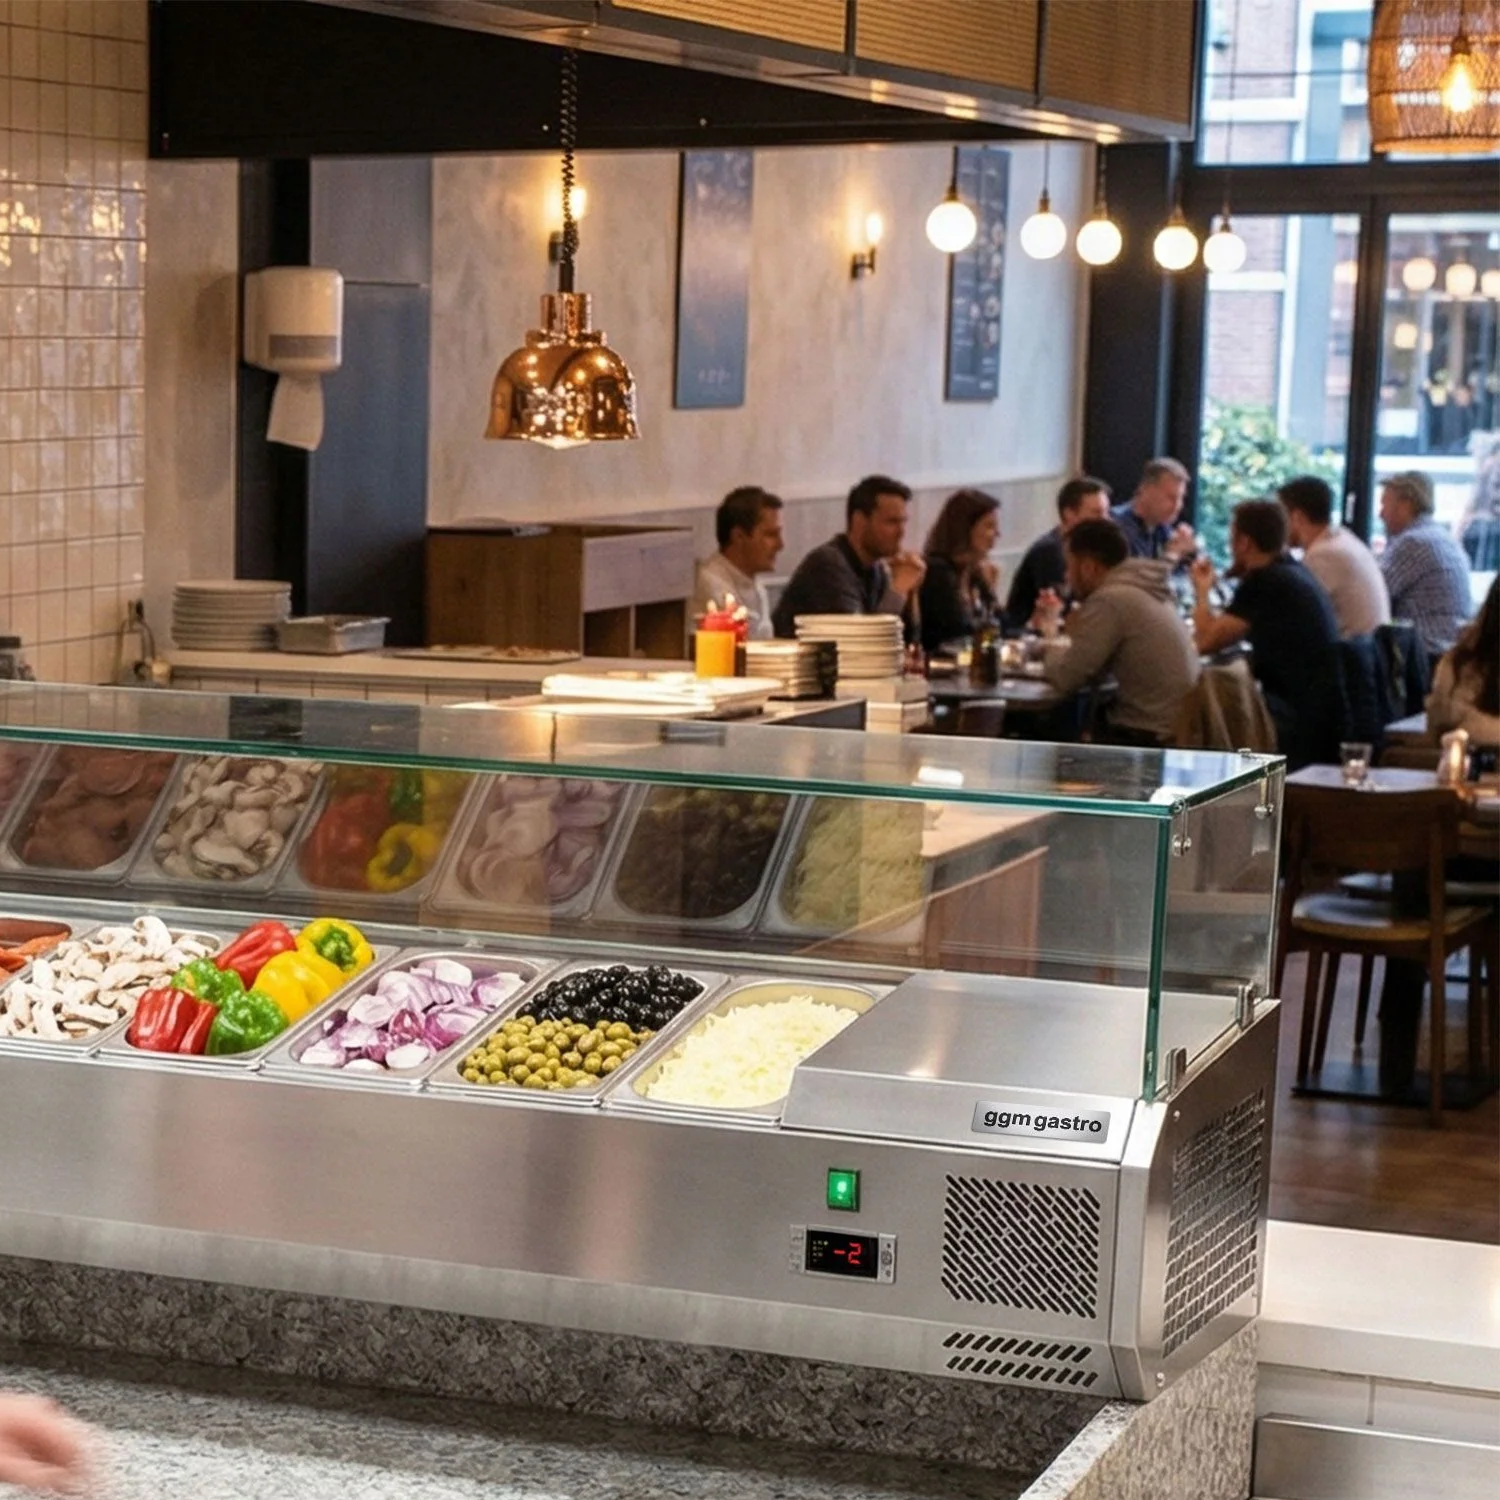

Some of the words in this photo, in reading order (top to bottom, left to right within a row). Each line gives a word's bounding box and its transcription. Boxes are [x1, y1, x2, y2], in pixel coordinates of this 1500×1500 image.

[984, 1110, 1031, 1128] ggm
[1033, 1114, 1102, 1133] gastro
[834, 1242, 861, 1264] -2
